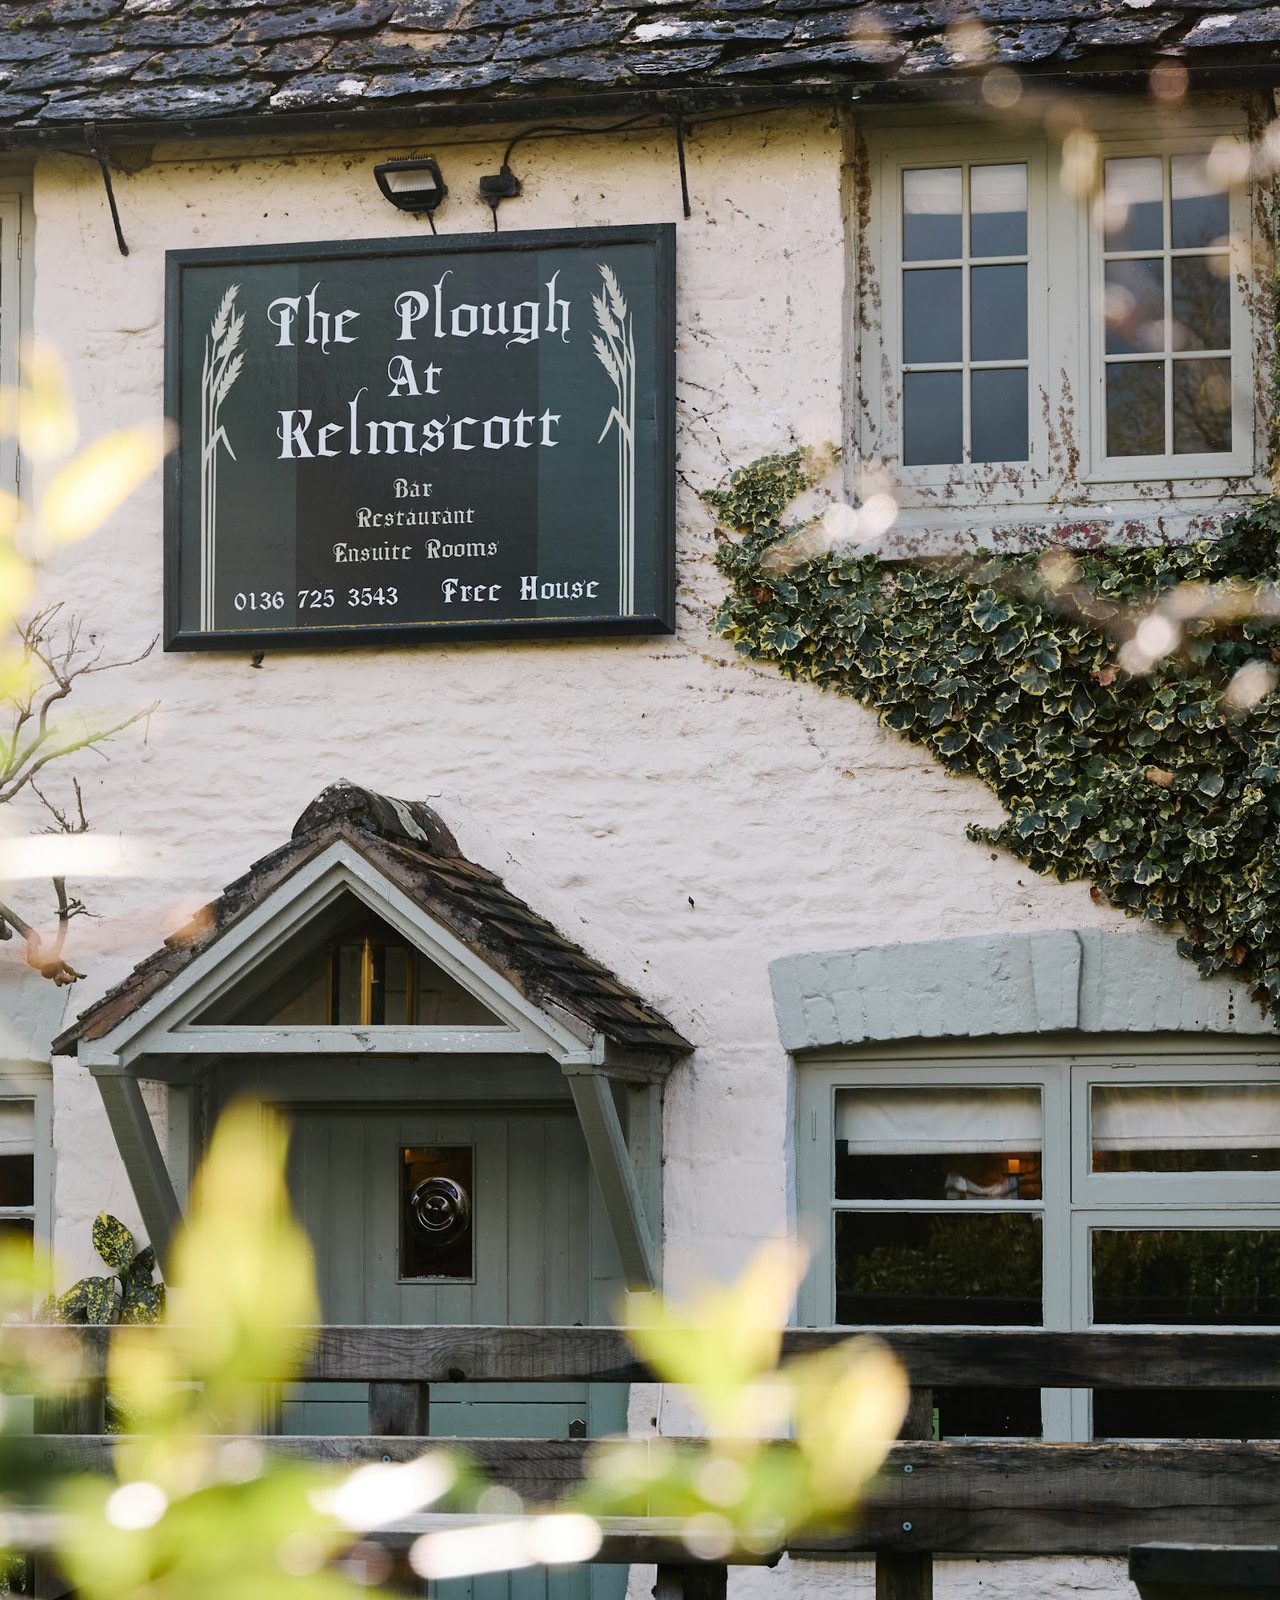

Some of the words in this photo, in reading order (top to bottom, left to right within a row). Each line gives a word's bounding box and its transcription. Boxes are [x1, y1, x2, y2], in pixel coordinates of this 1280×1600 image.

[266, 281, 361, 355] The
[394, 269, 572, 350] Plough
[387, 354, 443, 397] At
[276, 386, 562, 460] Kelmscott
[392, 477, 433, 499] Bar
[355, 507, 475, 528] Restaurant
[332, 540, 413, 563] Ensuite
[425, 538, 499, 559] Rooms
[233, 591, 285, 611] 0136
[297, 588, 335, 609] 725
[347, 586, 399, 607] 3543
[441, 578, 502, 604] Free
[519, 575, 600, 602] House
